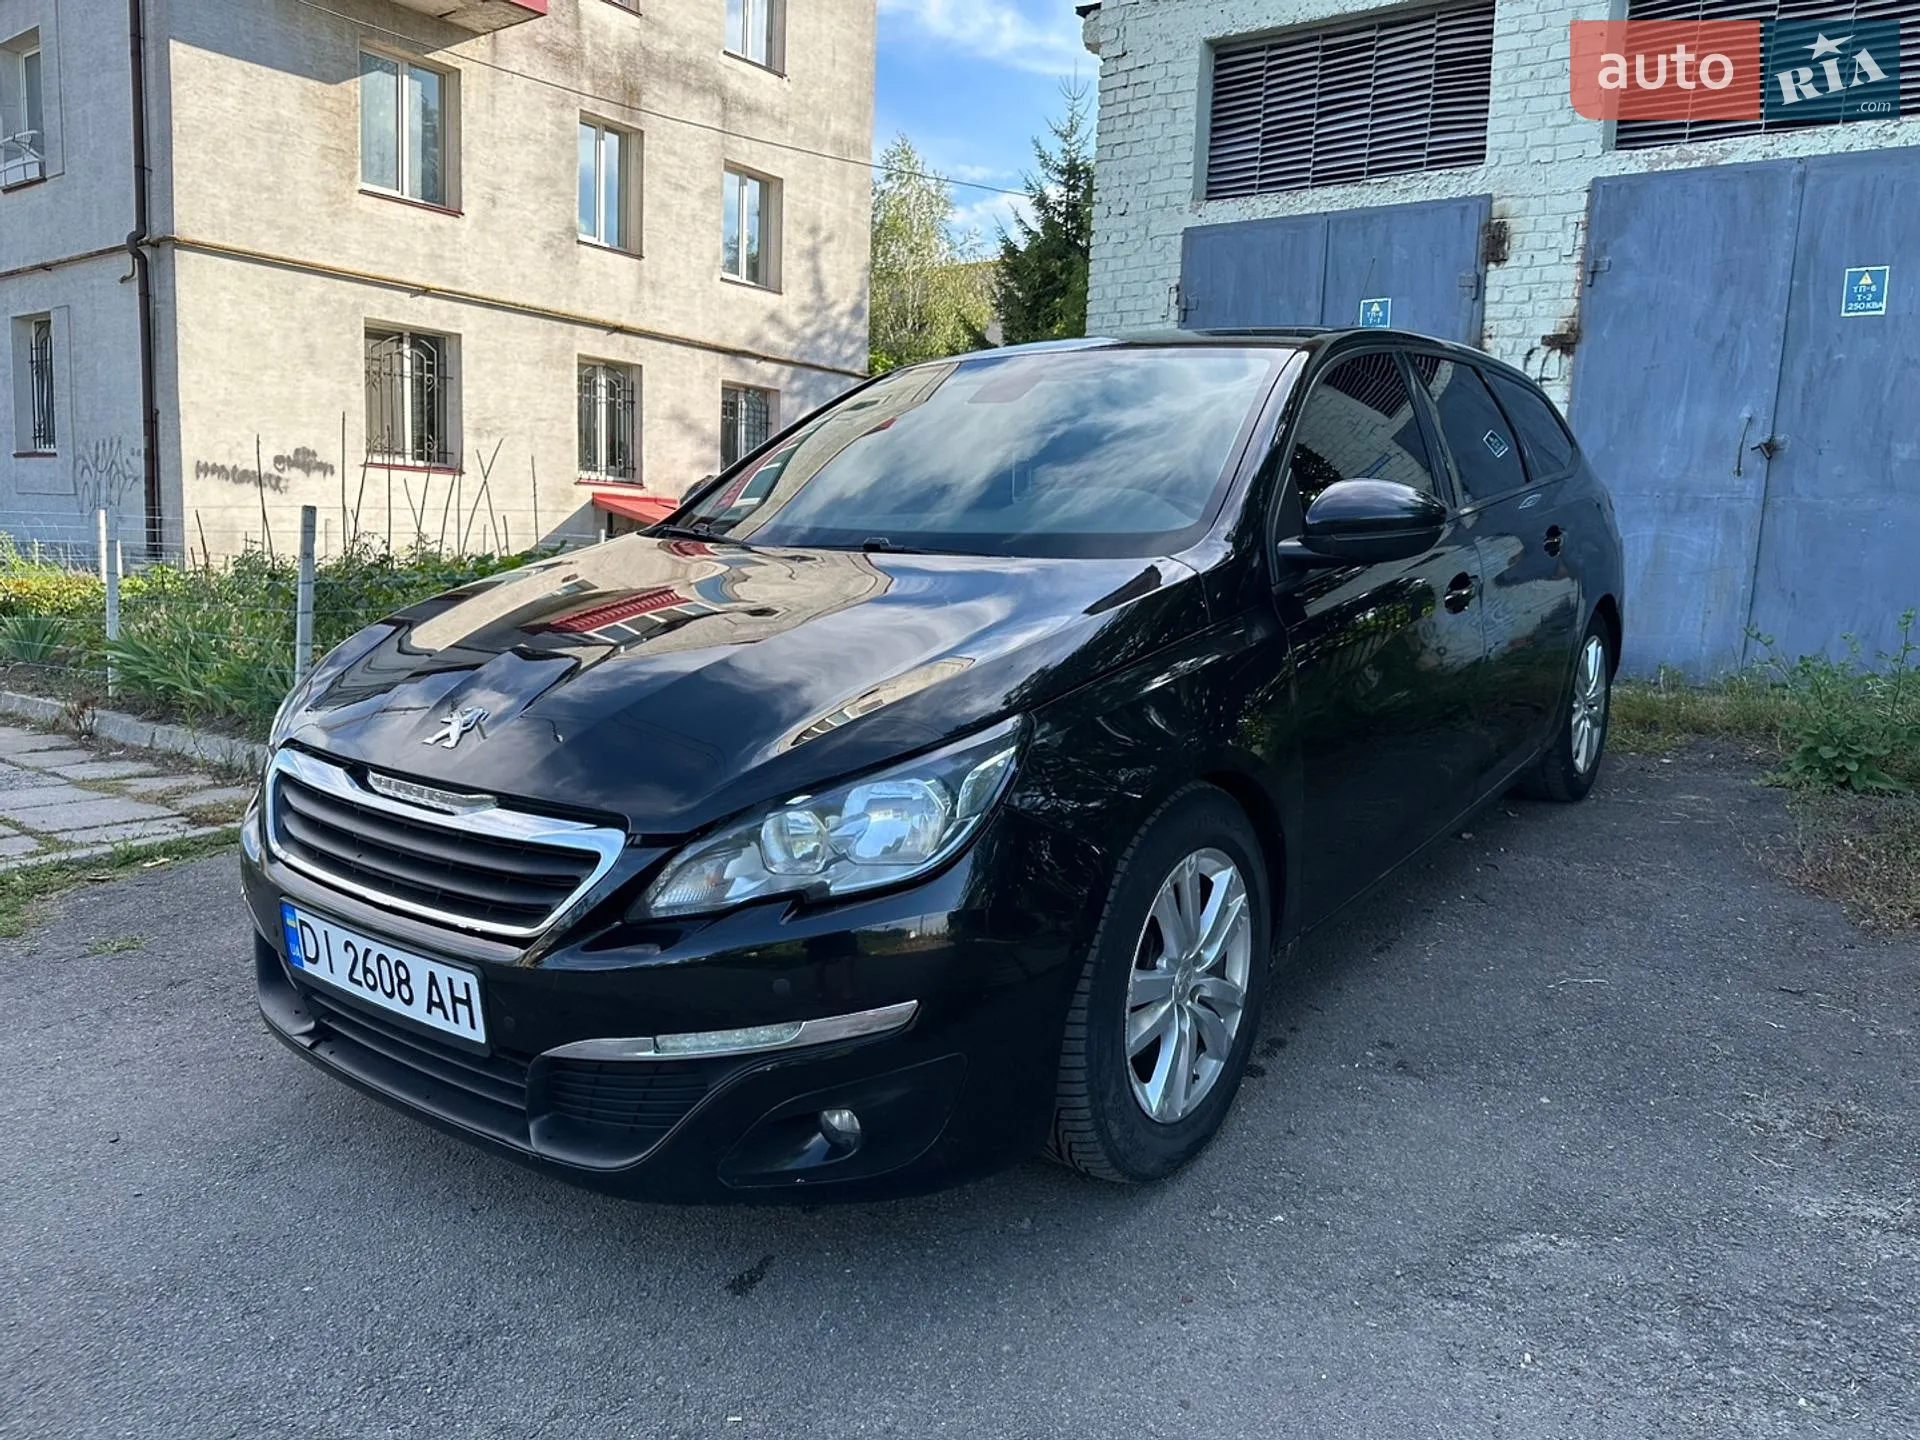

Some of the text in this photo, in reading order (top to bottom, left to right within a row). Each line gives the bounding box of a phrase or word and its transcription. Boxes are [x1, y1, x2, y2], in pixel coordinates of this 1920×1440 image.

[289, 942, 302, 959] UA
[300, 919, 476, 1030] DI 2608 AH
